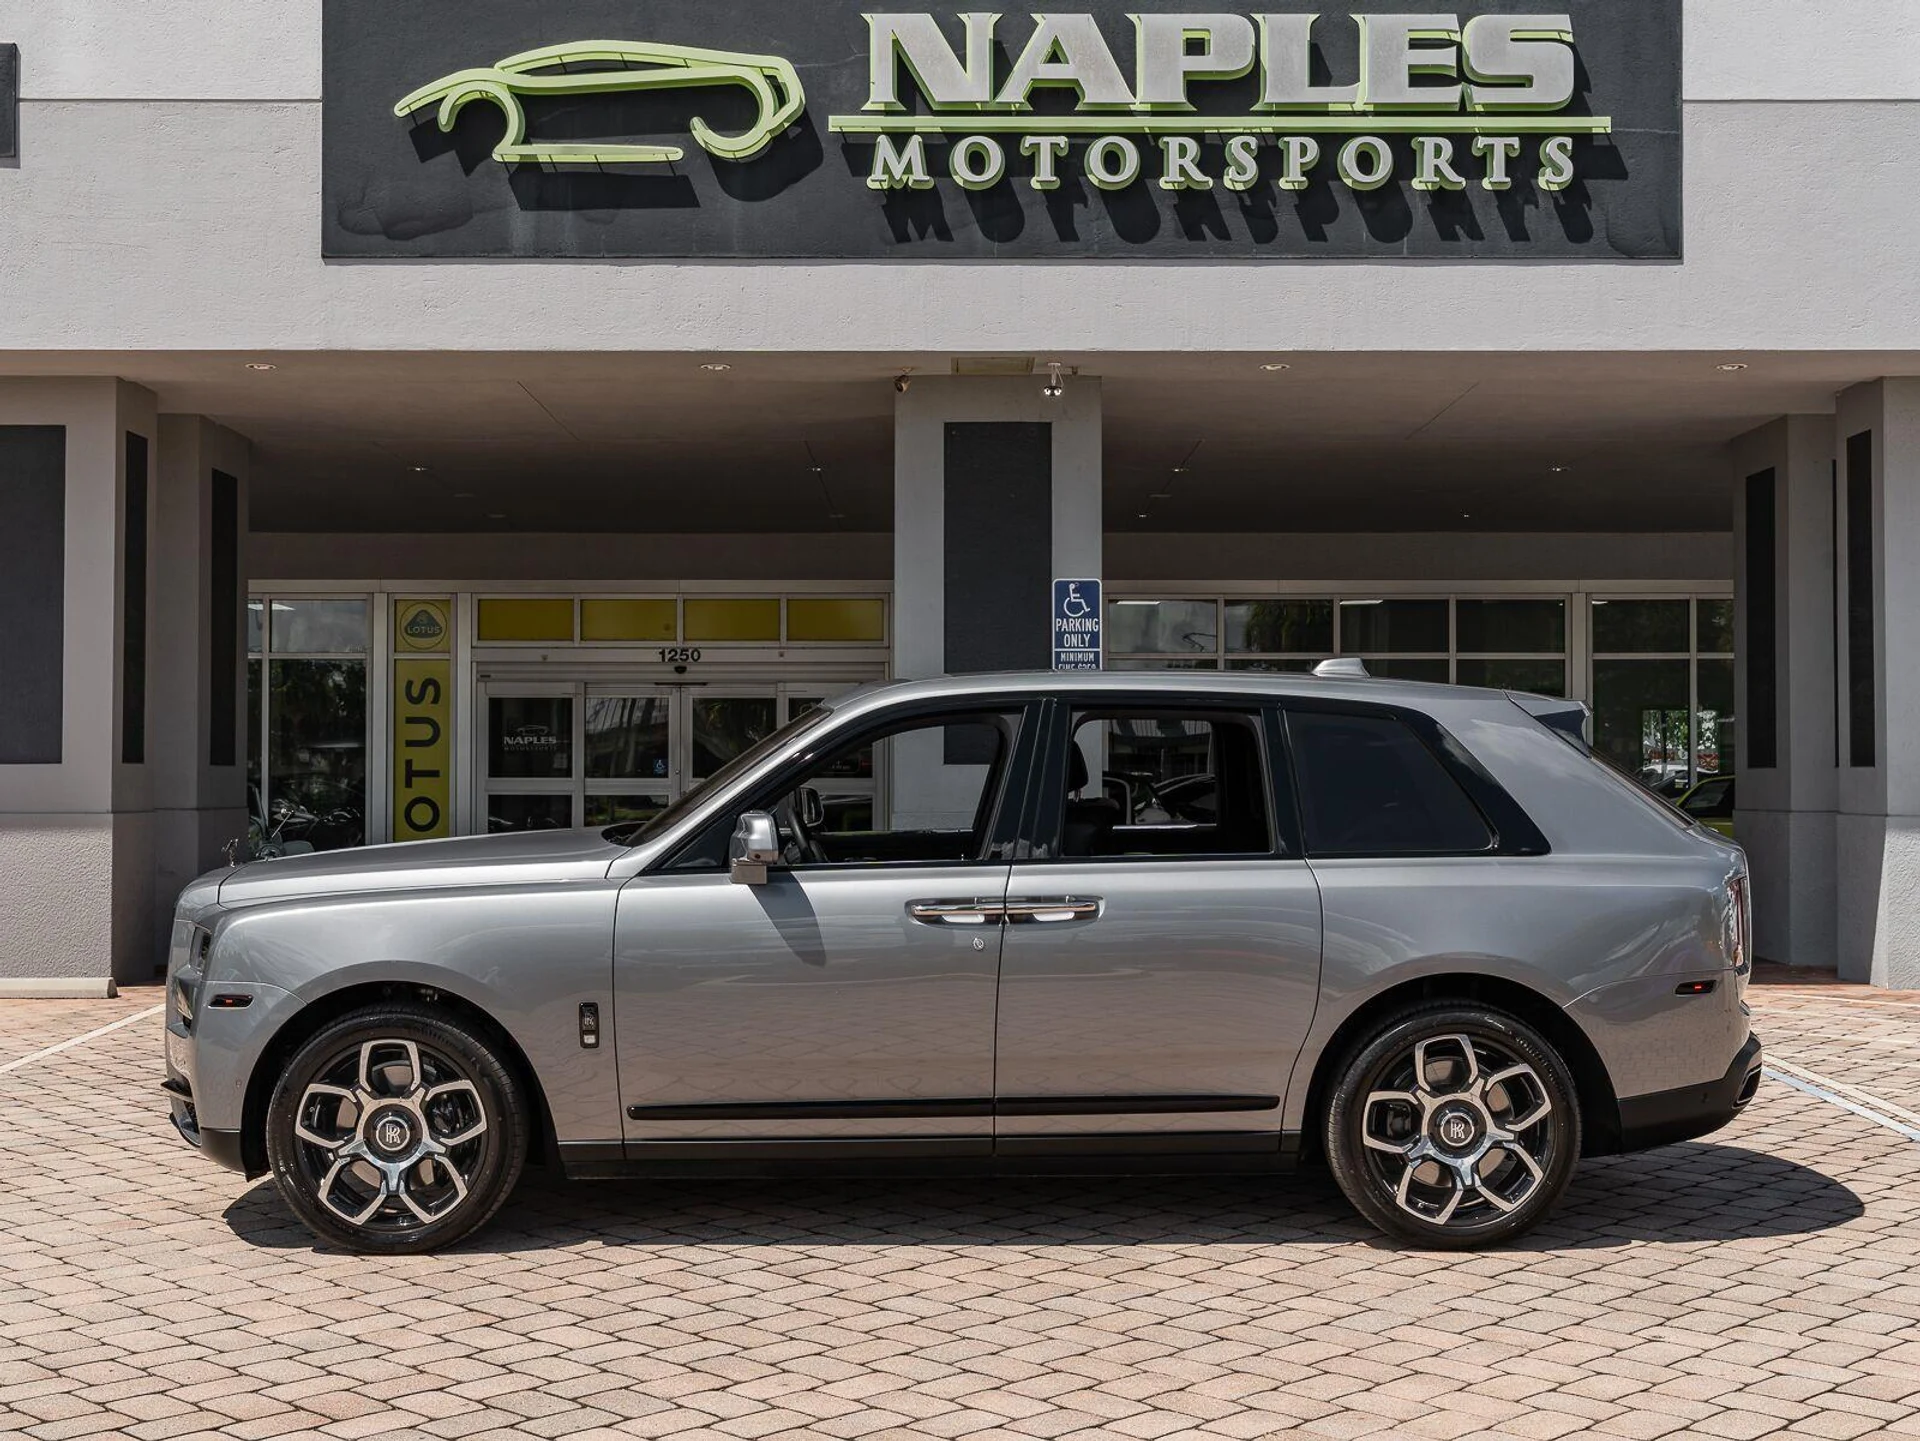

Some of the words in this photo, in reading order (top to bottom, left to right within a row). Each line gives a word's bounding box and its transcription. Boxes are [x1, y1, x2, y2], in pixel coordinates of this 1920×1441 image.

[862, 13, 1575, 111] NAPLES
[866, 134, 1575, 190] MOTORSPORTS
[407, 625, 441, 634] LOTUS
[1056, 618, 1099, 632] PARKING
[1063, 633, 1091, 647] ONLY
[659, 648, 701, 662] 1250
[1060, 652, 1095, 662] MINIMUM
[503, 736, 557, 744] NAPLES
[404, 677, 441, 833] OTUS
